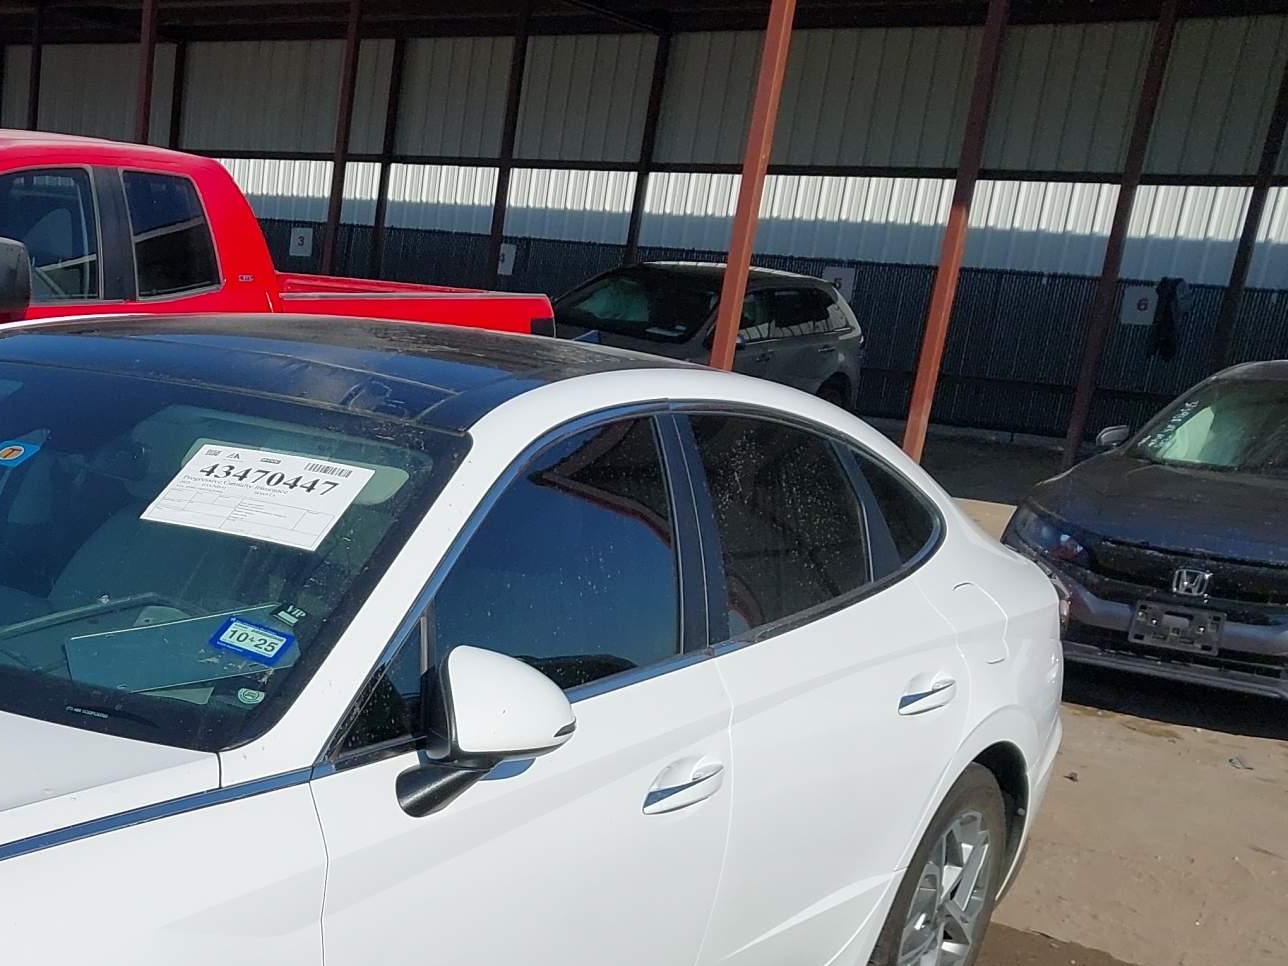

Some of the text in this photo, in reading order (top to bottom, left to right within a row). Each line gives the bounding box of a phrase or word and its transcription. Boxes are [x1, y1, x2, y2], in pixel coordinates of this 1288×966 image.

[296, 234, 305, 248] 3
[1136, 298, 1149, 312] 6
[199, 463, 339, 496] 43470447
